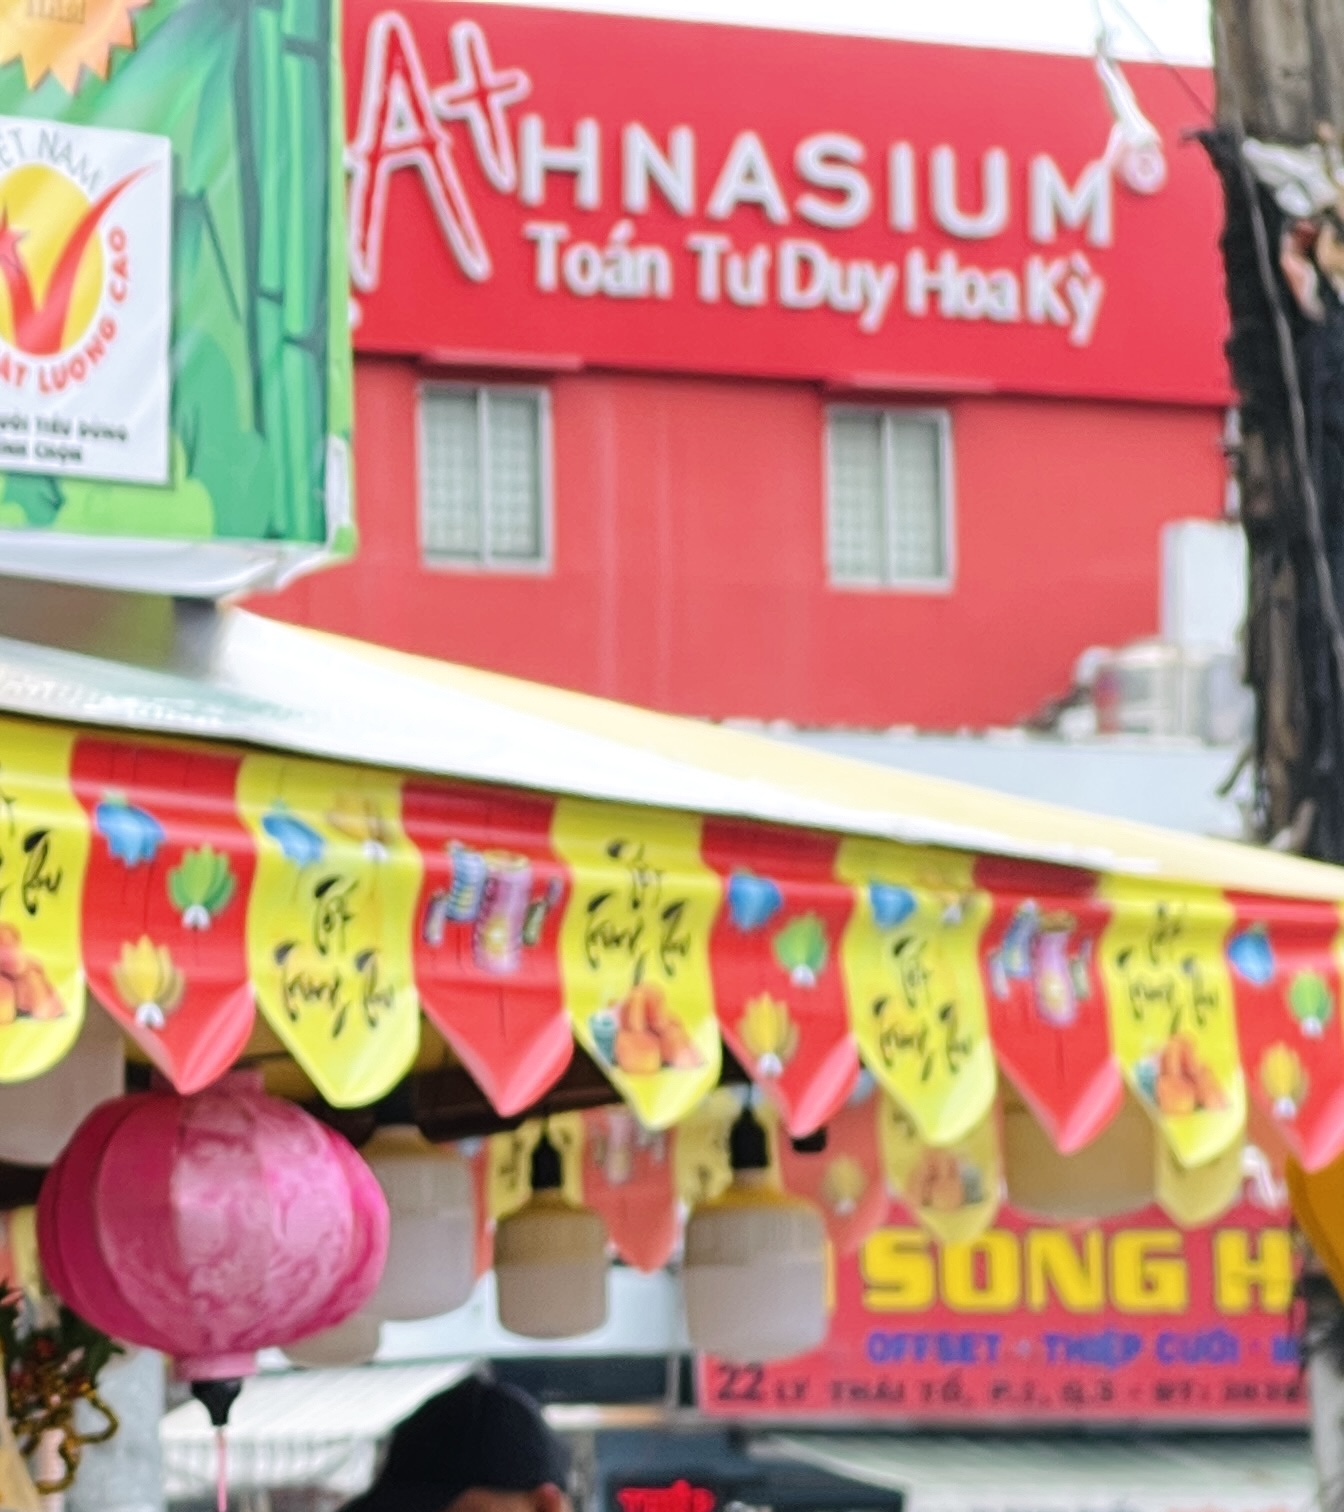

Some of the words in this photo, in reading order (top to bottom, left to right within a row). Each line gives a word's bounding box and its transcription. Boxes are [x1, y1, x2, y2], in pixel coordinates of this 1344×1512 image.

[523, 220, 672, 299] Toán
[687, 232, 770, 304] Tư
[778, 240, 896, 332] Duy
[862, 1227, 1191, 1314] SONG
